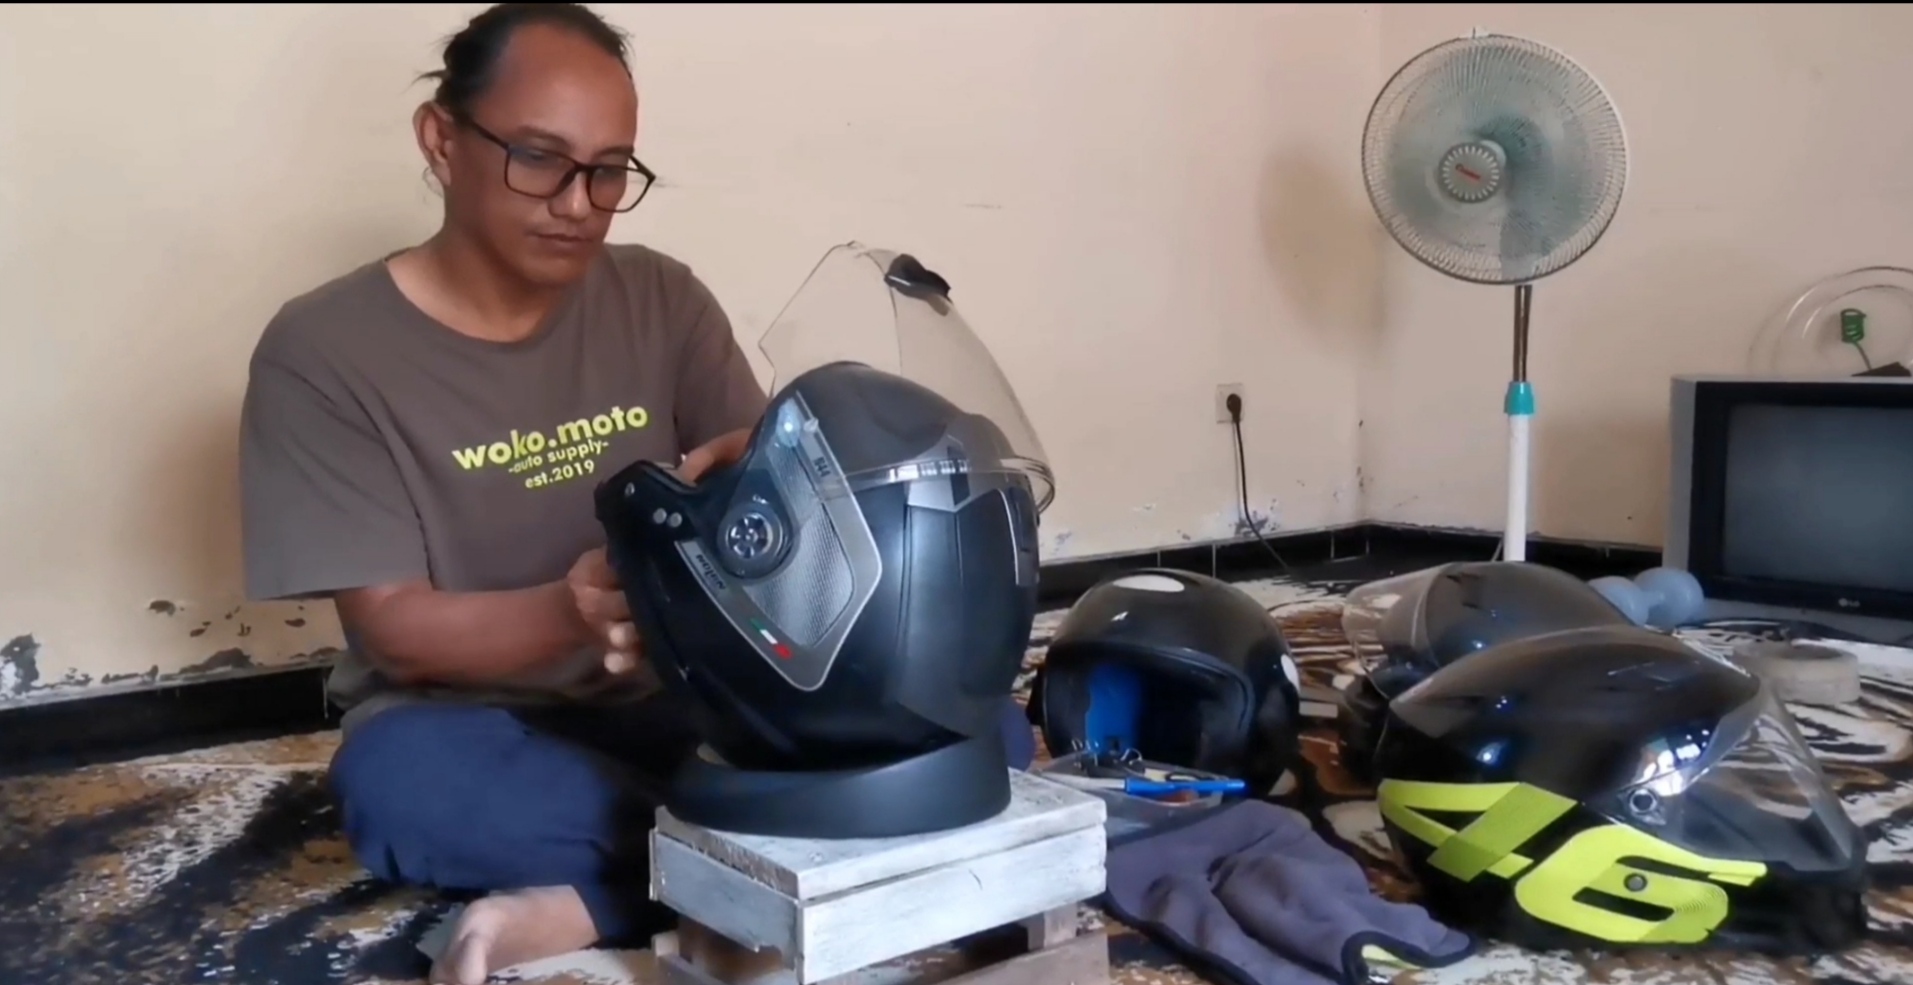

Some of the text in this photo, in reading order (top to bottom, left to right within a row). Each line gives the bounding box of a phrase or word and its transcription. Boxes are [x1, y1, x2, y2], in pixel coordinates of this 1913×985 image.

[452, 405, 648, 470] woko.moto
[525, 459, 595, 489] est.2019
[1377, 778, 1768, 944] 46
